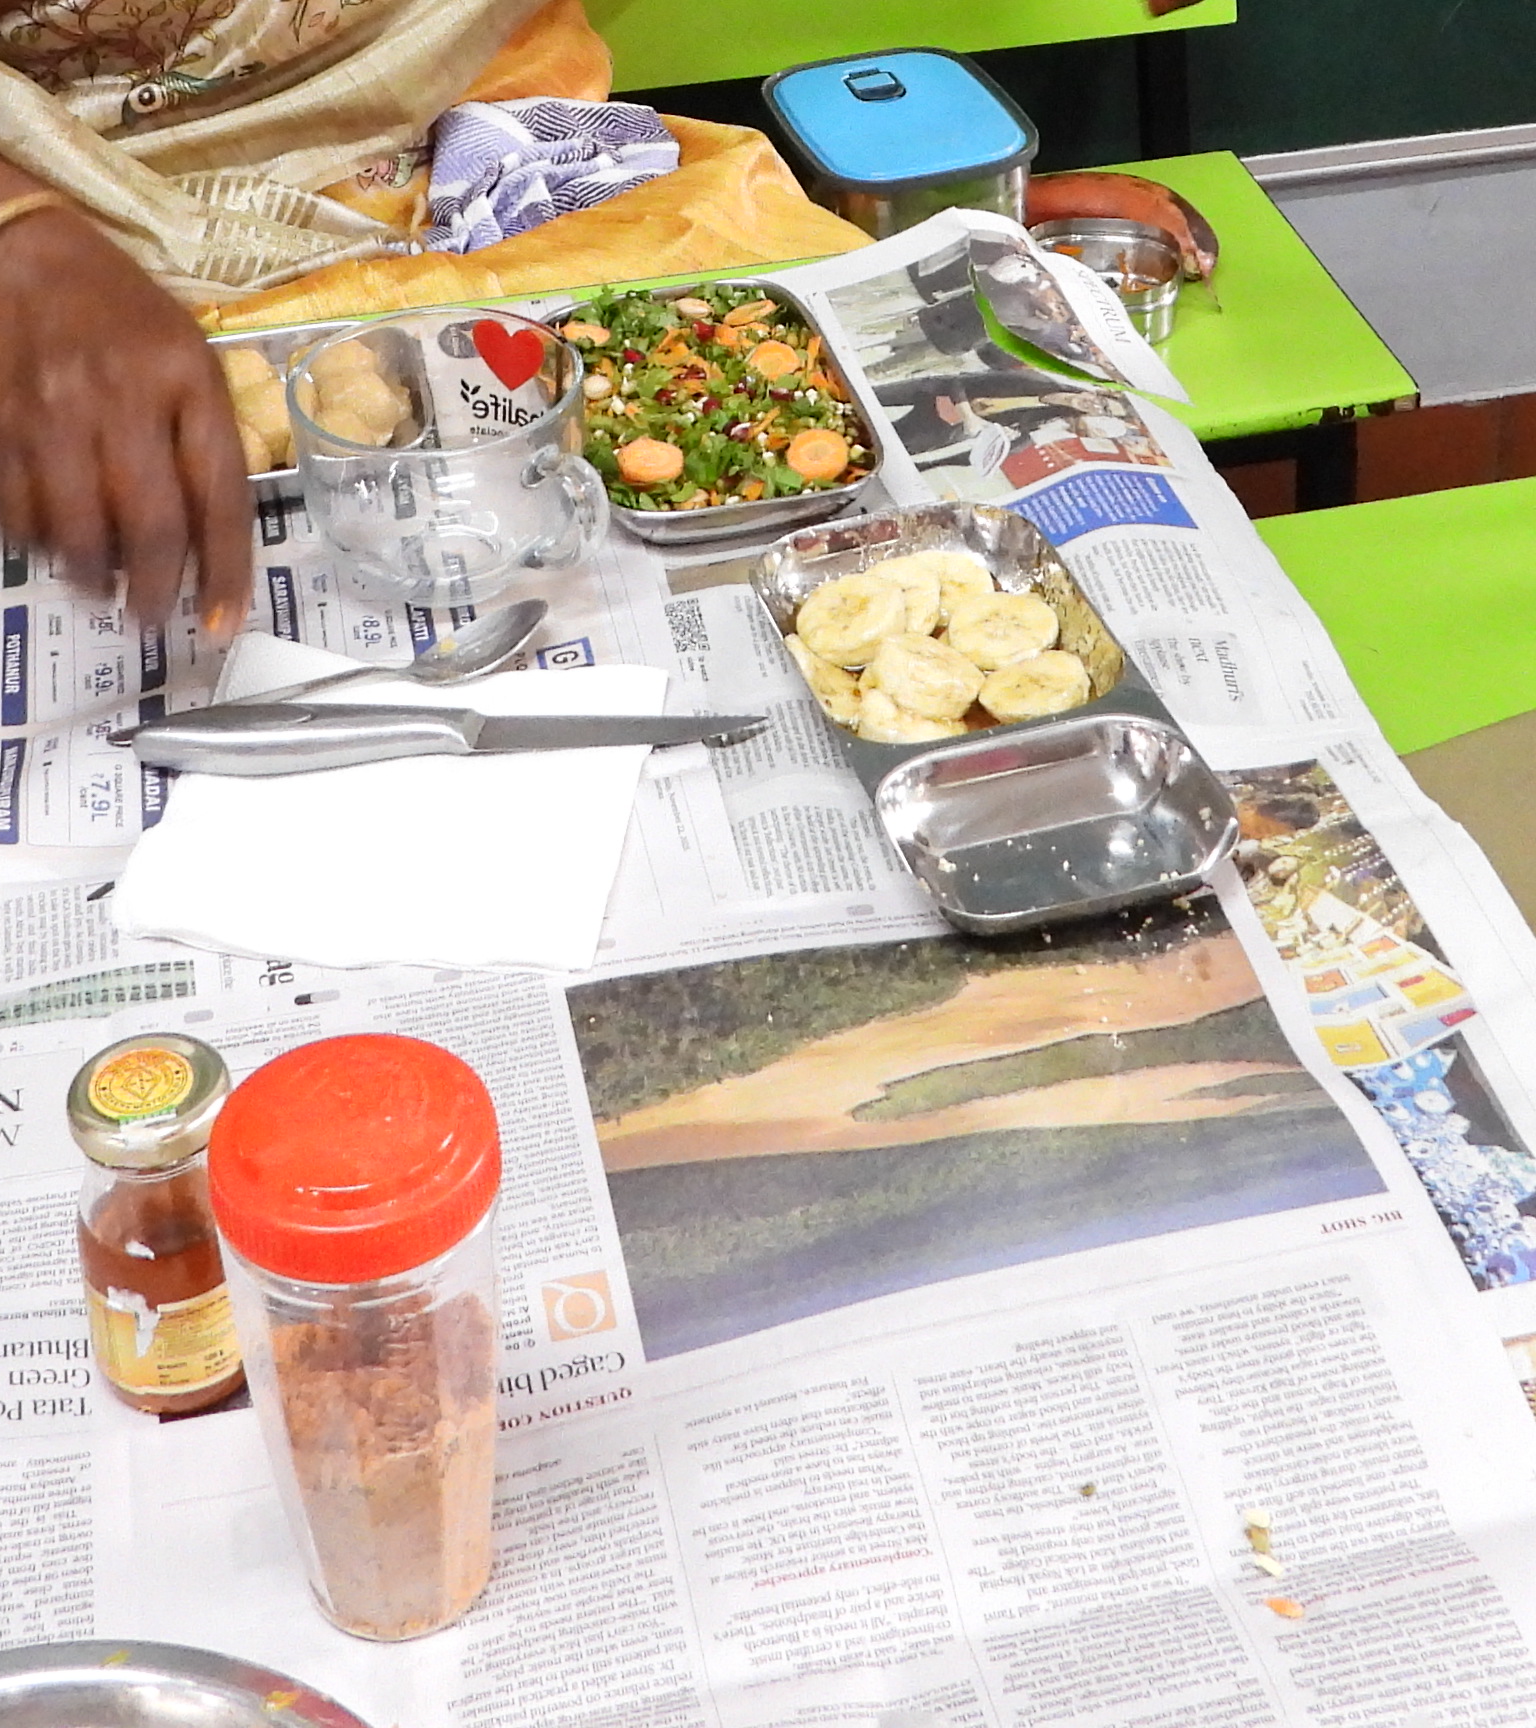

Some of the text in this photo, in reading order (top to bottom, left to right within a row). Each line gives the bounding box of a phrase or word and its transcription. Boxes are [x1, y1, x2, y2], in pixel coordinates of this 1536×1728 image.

[0, 633, 21, 694] POTHANUR
[113, 804, 124, 828] PRICE
[1320, 1209, 1403, 1233] BIG SHOT
[544, 1280, 606, 1329] Q
[7, 1367, 91, 1387] Green
[538, 1351, 625, 1391] Caged
[31, 1396, 94, 1419] Tata
[538, 1386, 632, 1421] QUESTION
[906, 1588, 944, 1603] device
[758, 1608, 833, 1630] headphones.
[896, 1603, 948, 1622] therapist.
[711, 1624, 756, 1642] There's
[822, 1620, 858, 1637] needs
[742, 1629, 801, 1653] Bluetooth
